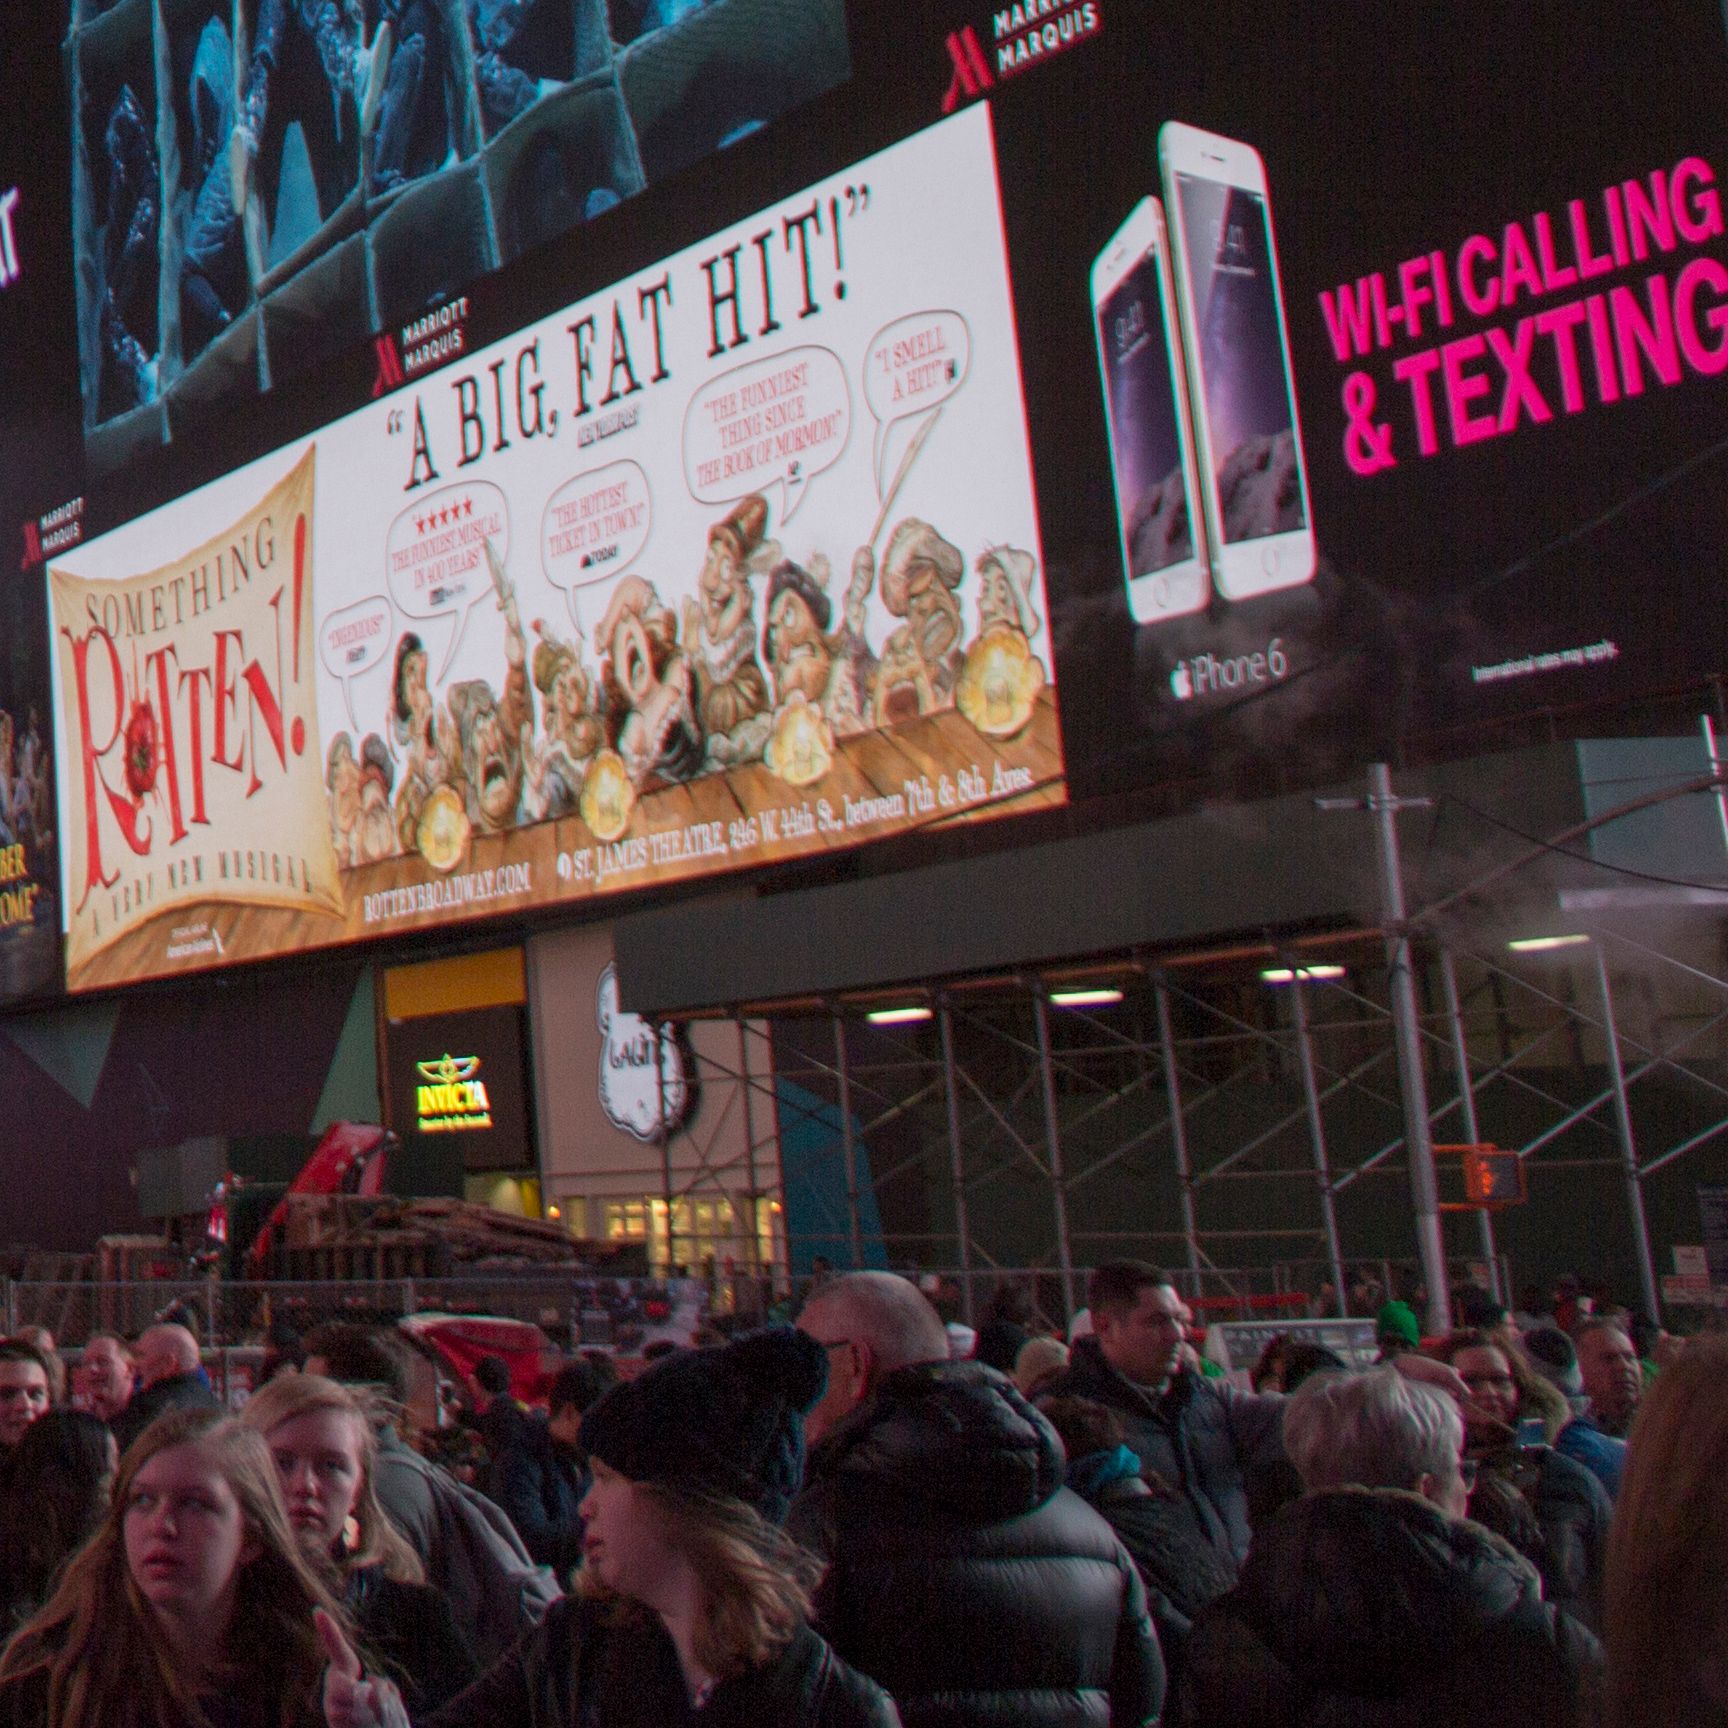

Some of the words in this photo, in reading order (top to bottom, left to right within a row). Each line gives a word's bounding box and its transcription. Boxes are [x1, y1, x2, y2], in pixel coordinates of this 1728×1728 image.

[996, 2, 1100, 74] MARQUIS
[1318, 250, 1454, 364] WI-FI
[1458, 155, 1723, 319] CALLING
[400, 296, 469, 345] MARRIOTT
[403, 326, 464, 371] MARQUIS
[891, 326, 945, 369] SMELL
[451, 336, 561, 471] BIG,
[567, 270, 673, 420] FAT
[740, 361, 810, 413] FUNNIEST
[1343, 371, 1397, 476] &
[1394, 257, 1728, 458] TEXTING
[719, 416, 762, 450] THING
[763, 393, 806, 427] SINCE
[39, 496, 84, 528] MARRIOTT
[578, 480, 629, 518] HOTTEST
[41, 519, 81, 552] MARQUIS
[549, 524, 586, 559] TICKET
[84, 514, 278, 638] SOMETHING
[1190, 646, 1267, 696] iPhone
[1268, 637, 1288, 680] 6
[595, 841, 648, 883] JAMES
[842, 792, 906, 828] between
[903, 779, 935, 816] 7th
[111, 871, 153, 922] VERY
[167, 854, 202, 891] NEW
[218, 848, 312, 894] MUSICAL
[363, 861, 533, 923] ROTTENBROADWAY.COM
[416, 1081, 490, 1114] INVICTA
